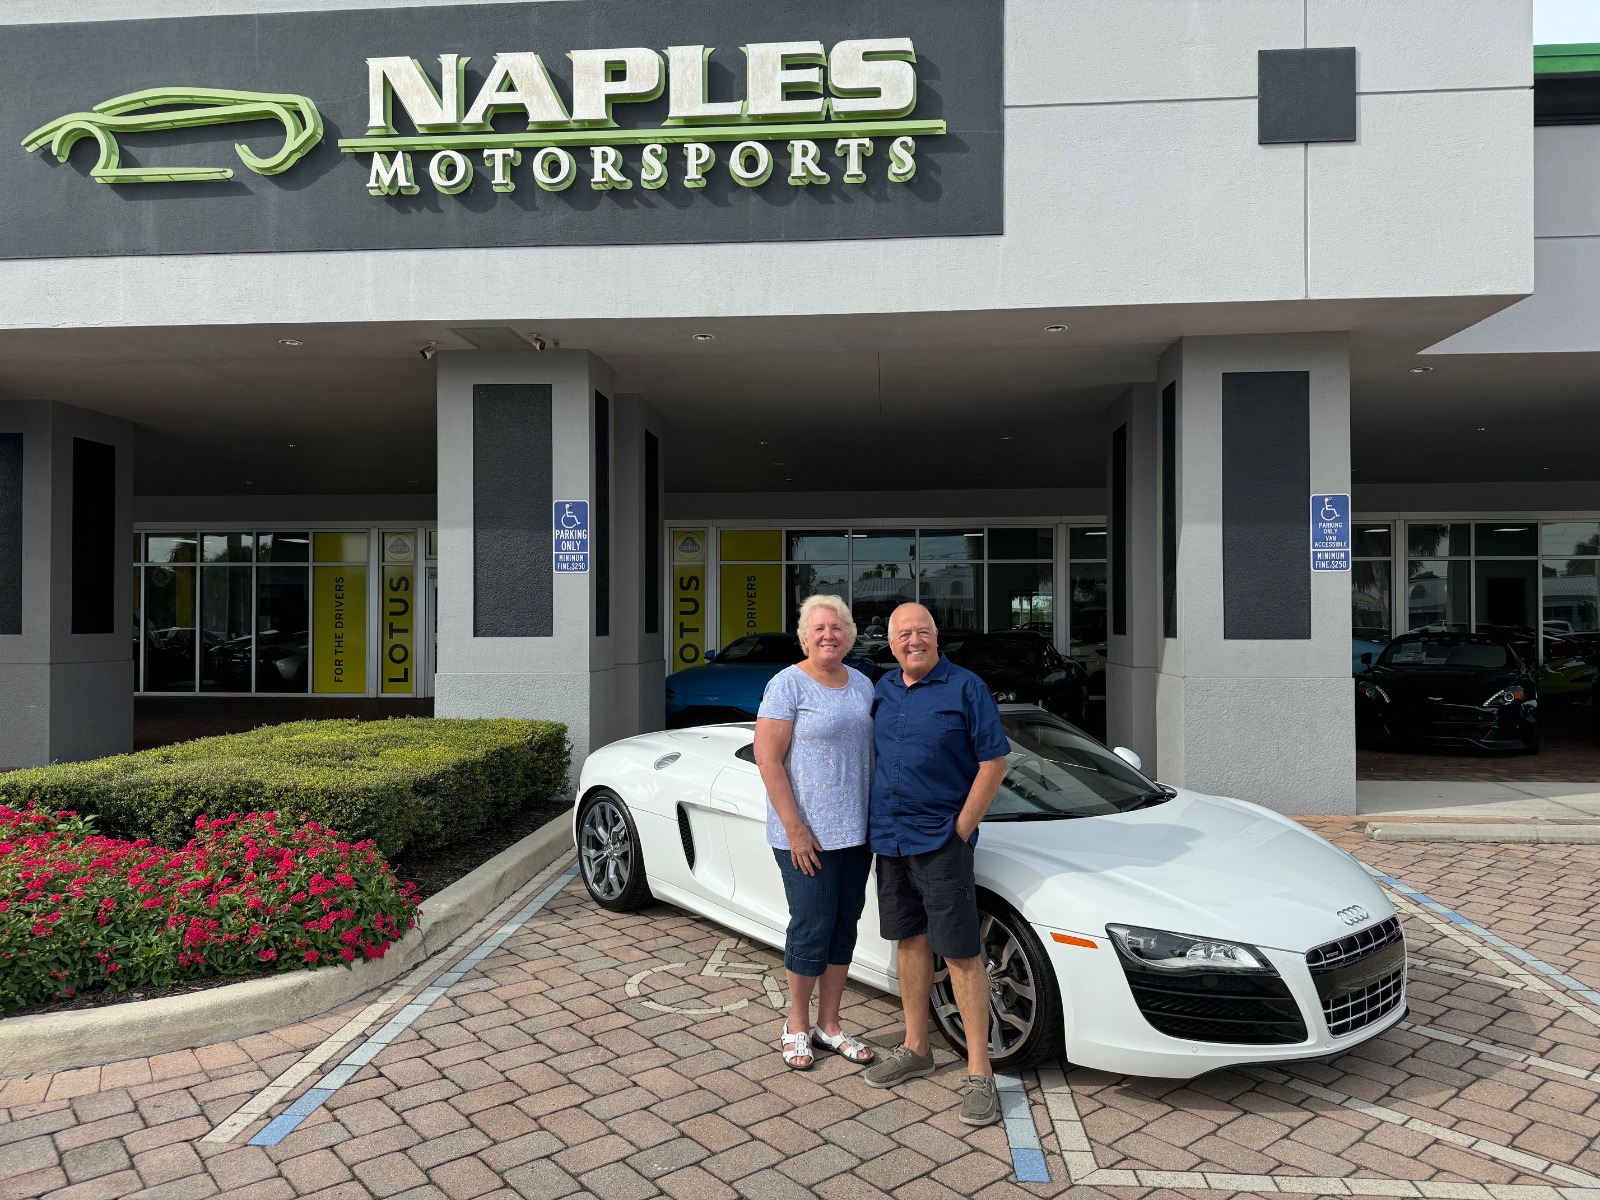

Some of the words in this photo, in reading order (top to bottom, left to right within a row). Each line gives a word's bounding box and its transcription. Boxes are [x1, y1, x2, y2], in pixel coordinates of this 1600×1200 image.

[365, 37, 918, 134] NAPLES
[366, 135, 920, 197] MOTORSPORTS
[556, 530, 587, 540] PARKING
[561, 541, 581, 550] ONLY
[572, 562, 585, 570] $250
[1332, 560, 1346, 569] $250
[335, 576, 344, 628] DRIVERS
[679, 576, 700, 664] OTUS
[747, 576, 756, 628] DRIVERS
[335, 632, 344, 654] THE
[388, 576, 410, 682] LOTUS
[334, 659, 344, 682] FOR
